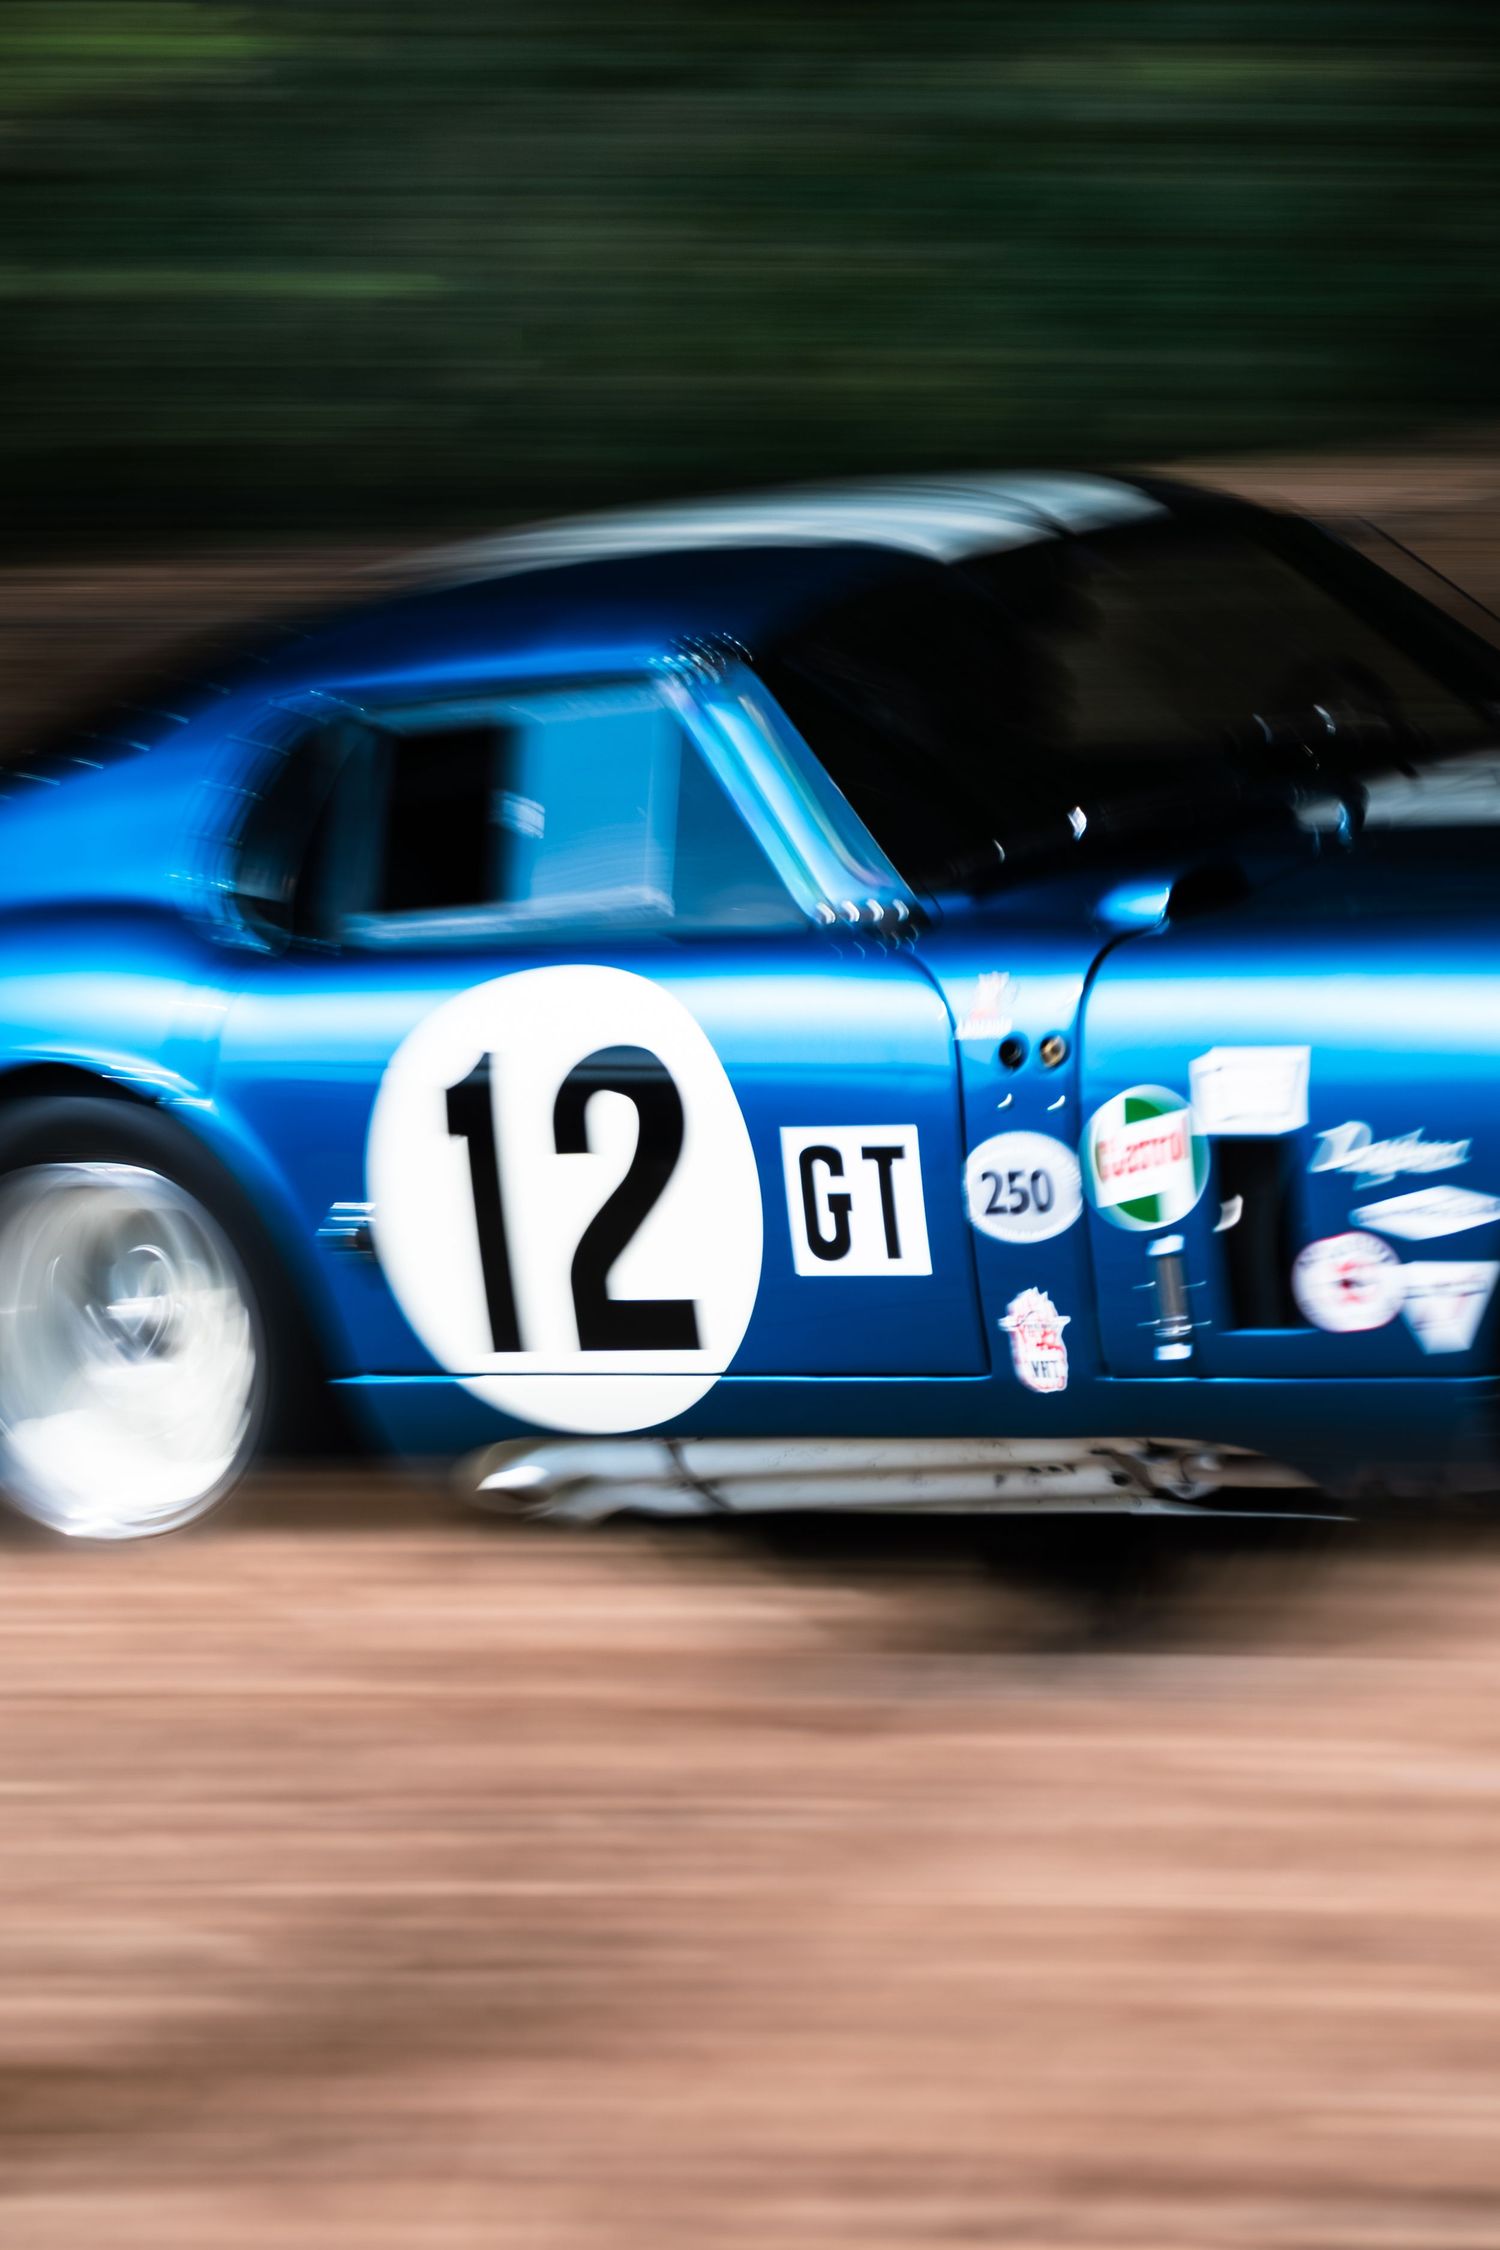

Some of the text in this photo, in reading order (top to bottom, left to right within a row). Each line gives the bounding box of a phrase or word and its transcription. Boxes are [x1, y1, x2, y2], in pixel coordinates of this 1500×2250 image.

[443, 1044, 706, 1353] 12
[798, 1144, 906, 1261] GT
[980, 1168, 1056, 1216] 250
